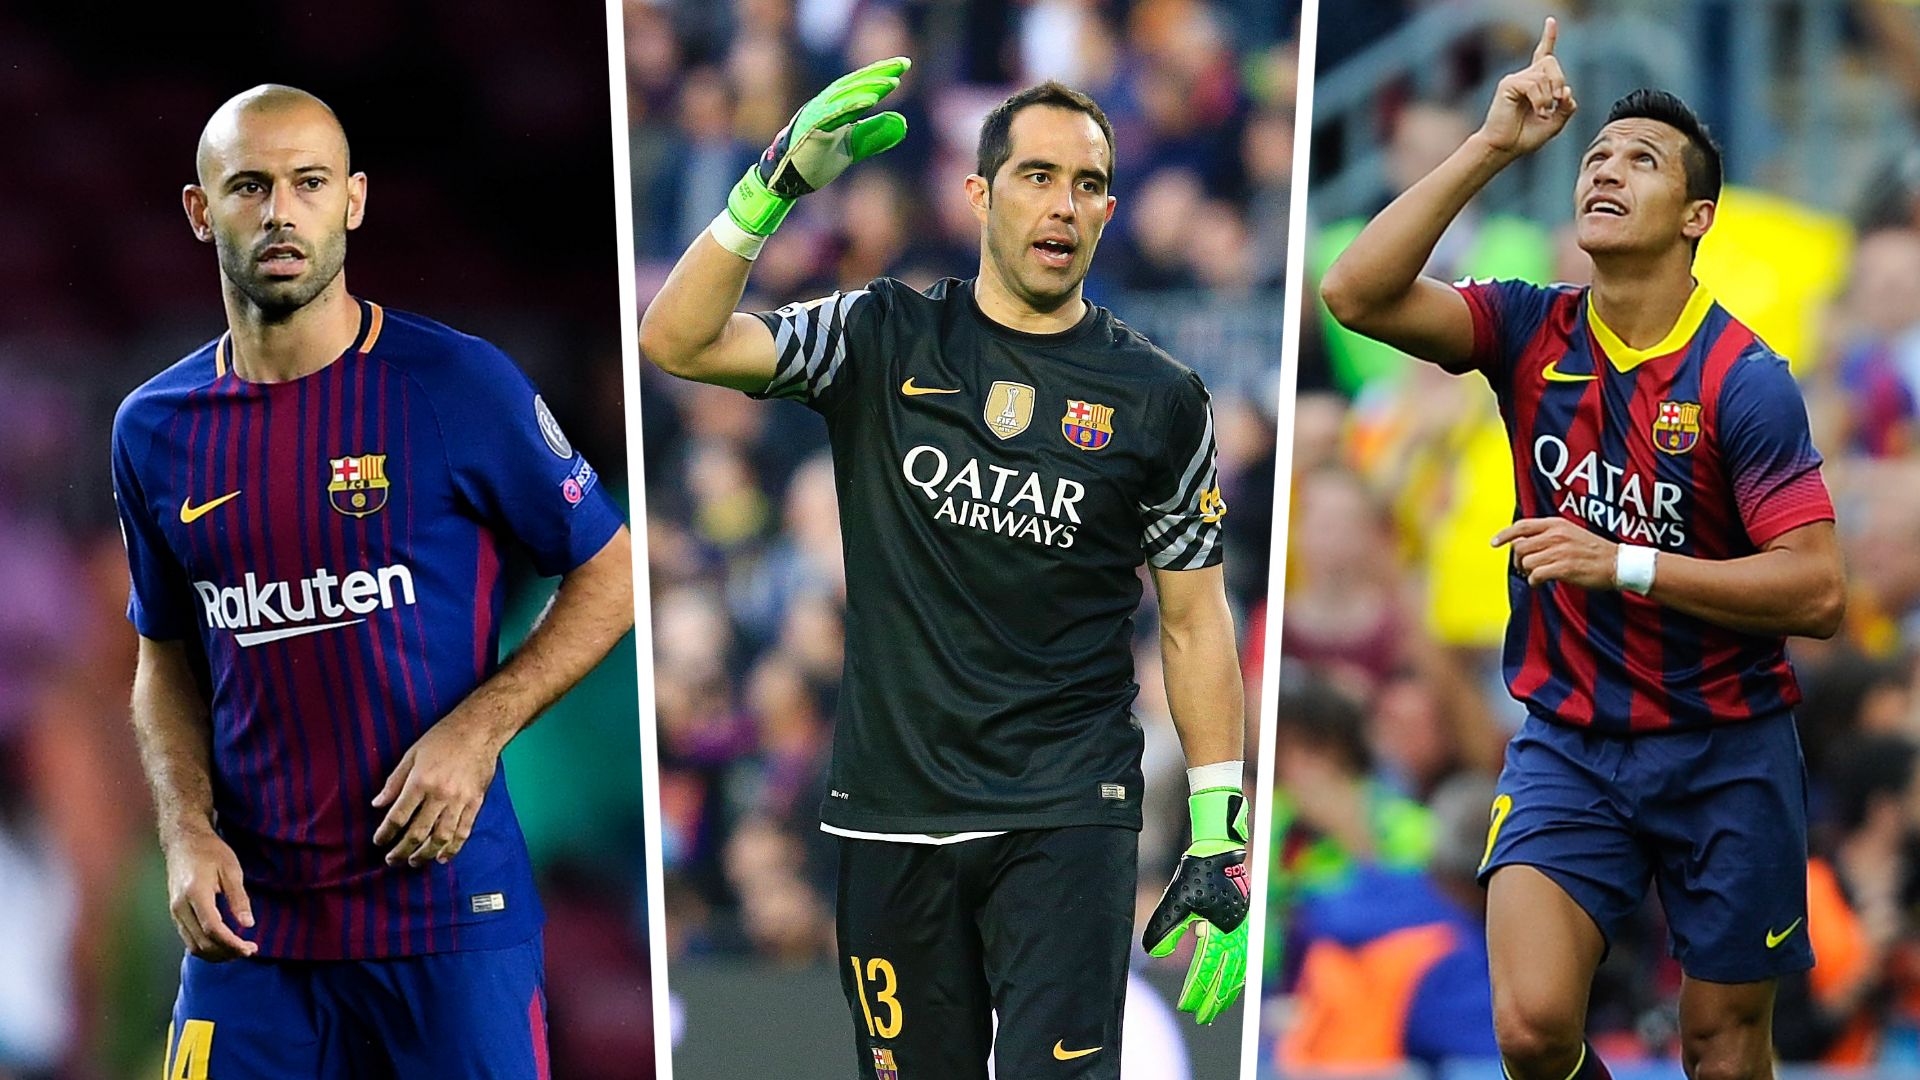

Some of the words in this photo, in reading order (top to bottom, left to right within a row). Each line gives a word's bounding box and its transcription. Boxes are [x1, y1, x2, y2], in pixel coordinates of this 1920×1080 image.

[1078, 418, 1097, 429] FCB
[902, 445, 1085, 524] QATAR
[1534, 434, 1684, 521] QATAR
[933, 496, 1077, 548] AIRWAYS
[1558, 490, 1685, 547] AIRWAYS
[193, 564, 416, 629] Rakuten
[850, 956, 903, 1039] 13
